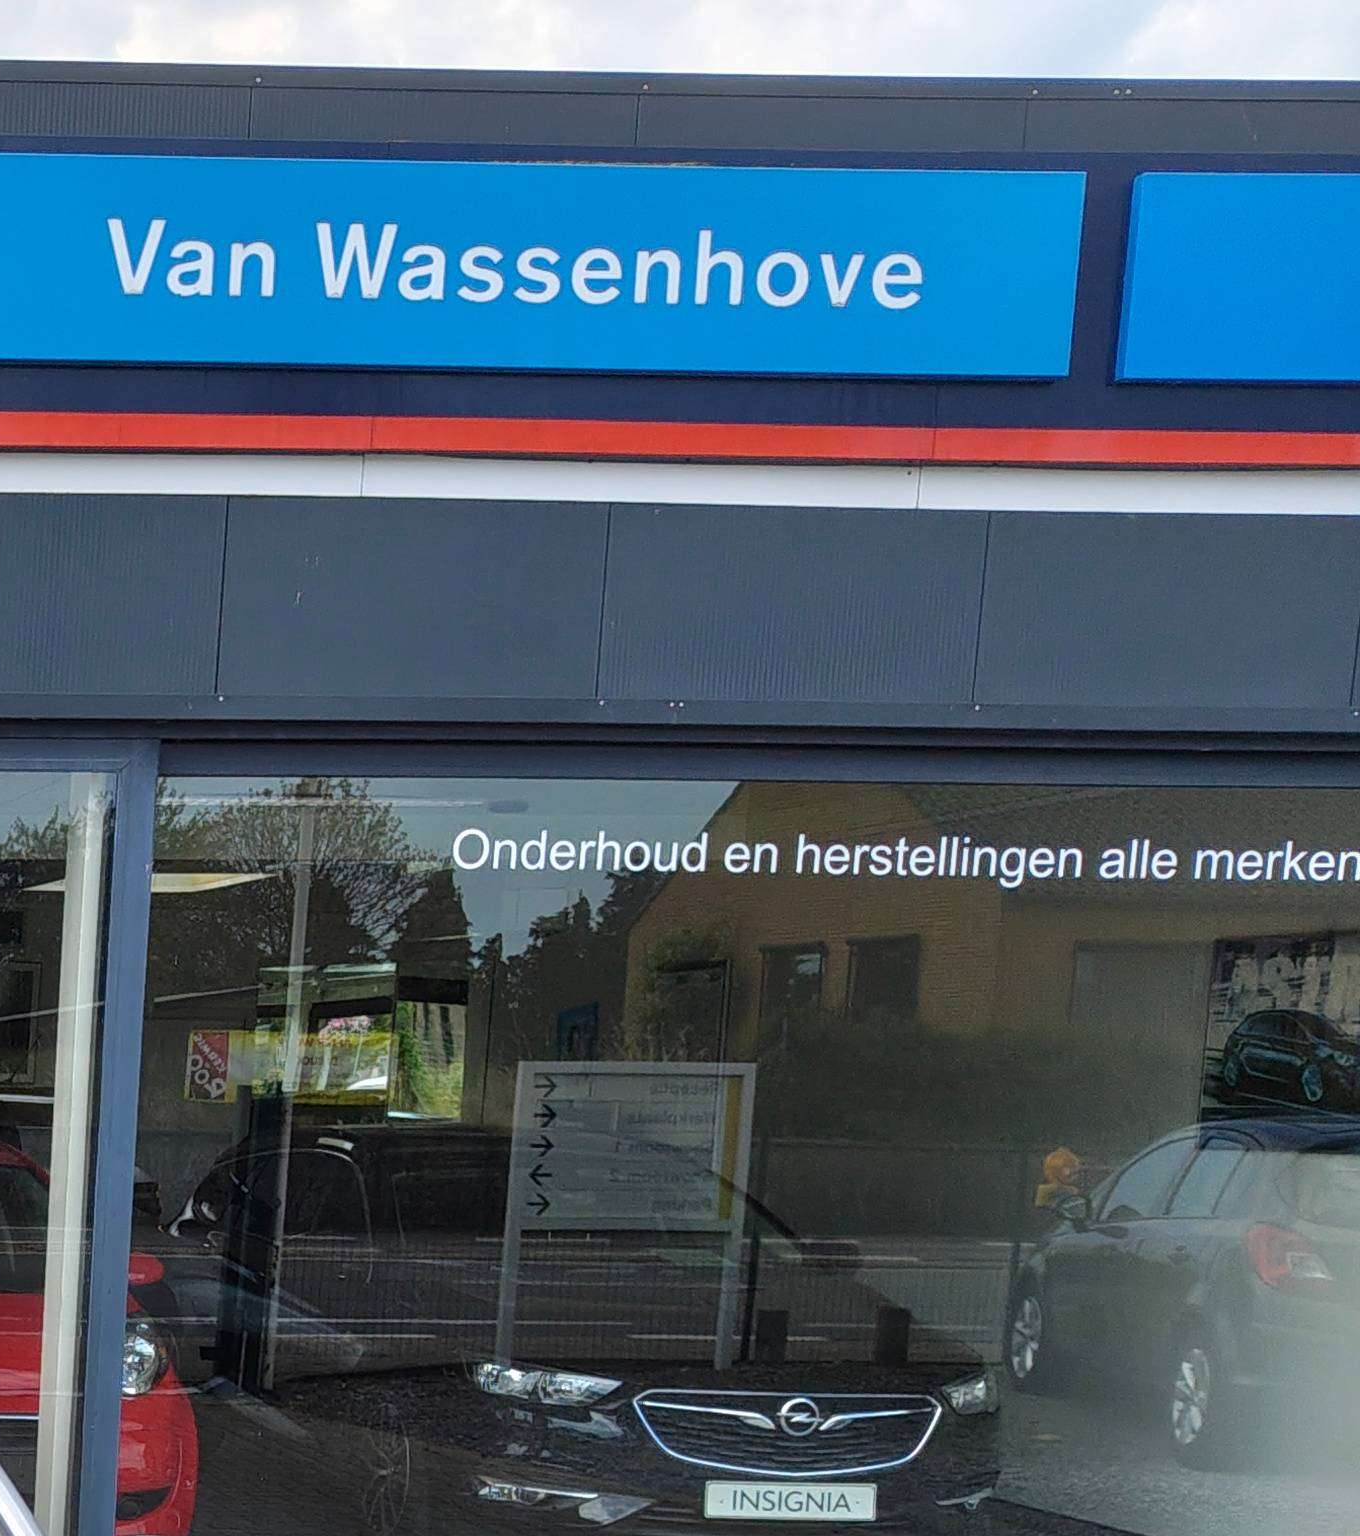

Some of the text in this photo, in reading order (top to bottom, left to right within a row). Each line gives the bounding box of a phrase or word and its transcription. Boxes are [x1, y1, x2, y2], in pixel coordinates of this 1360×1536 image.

[108, 218, 924, 310] Van Wassenhove
[451, 827, 1360, 889] Onderhoud en herstellingen alle merken
[731, 1489, 853, 1513] INSIGNIA
